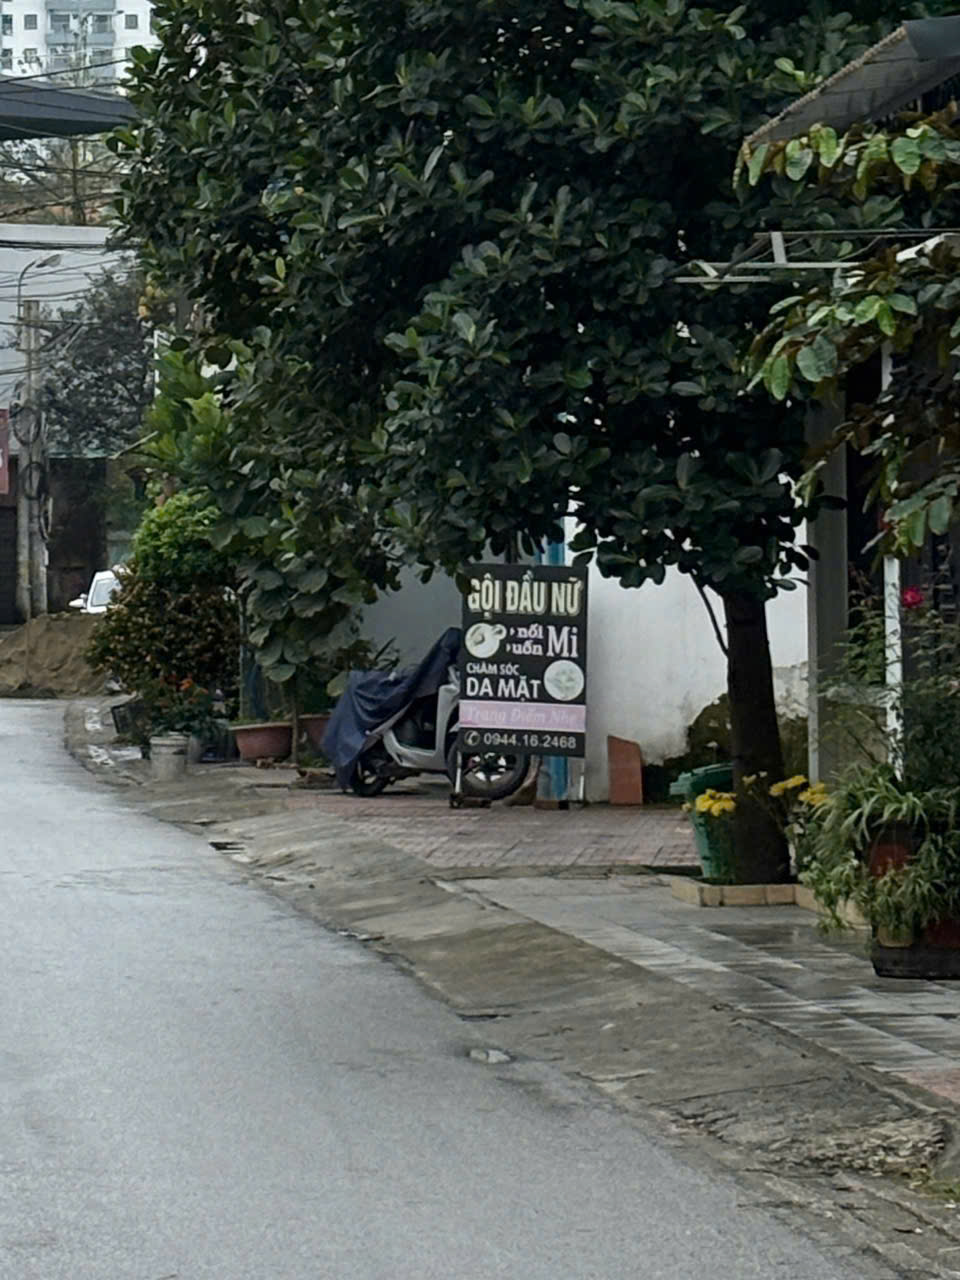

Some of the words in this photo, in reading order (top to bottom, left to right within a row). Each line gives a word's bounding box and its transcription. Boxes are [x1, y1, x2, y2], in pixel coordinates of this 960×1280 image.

[467, 572, 501, 619] GỘI
[505, 570, 546, 615] ĐẦU
[551, 577, 583, 616] NỮ
[512, 640, 544, 656] uốn
[517, 623, 544, 639] nối
[546, 625, 579, 658] Mi
[499, 662, 520, 676] SÓC
[466, 677, 494, 697] DA
[497, 675, 542, 702] MẶT
[483, 732, 577, 749] 0944.16.2468
